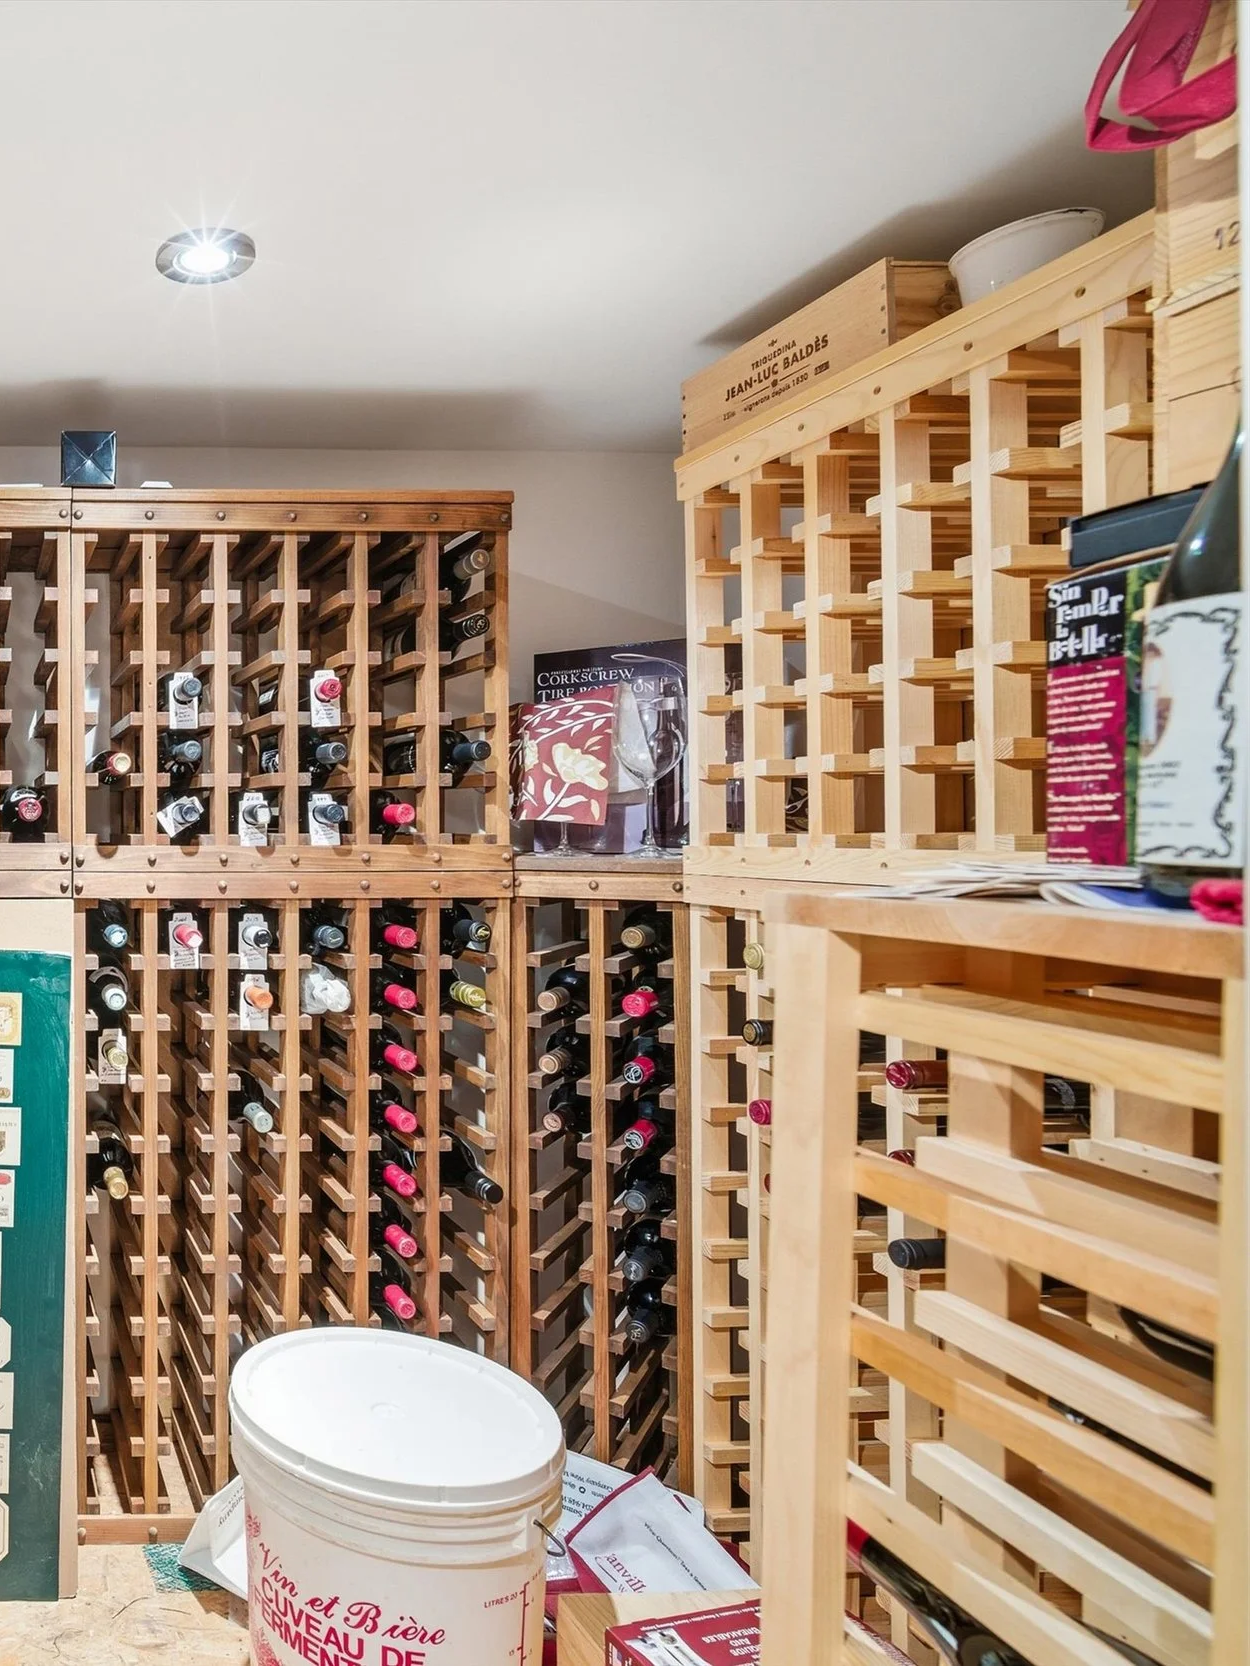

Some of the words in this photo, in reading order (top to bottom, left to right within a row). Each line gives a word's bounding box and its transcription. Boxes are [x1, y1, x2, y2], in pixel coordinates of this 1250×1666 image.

[725, 362, 779, 402] JEAN-LUC
[782, 334, 829, 370] BALDÈS
[751, 339, 797, 371] TRIQUEDINA
[537, 667, 635, 688] CORKSCREW
[259, 1542, 299, 1598] Vin
[304, 1595, 342, 1619] et
[605, 1553, 648, 1595] anvill
[483, 1595, 510, 1609] LITRES
[261, 1576, 365, 1661] CUVEAU
[381, 1645, 426, 1666] DE
[729, 1644, 761, 1657] QUIDS
